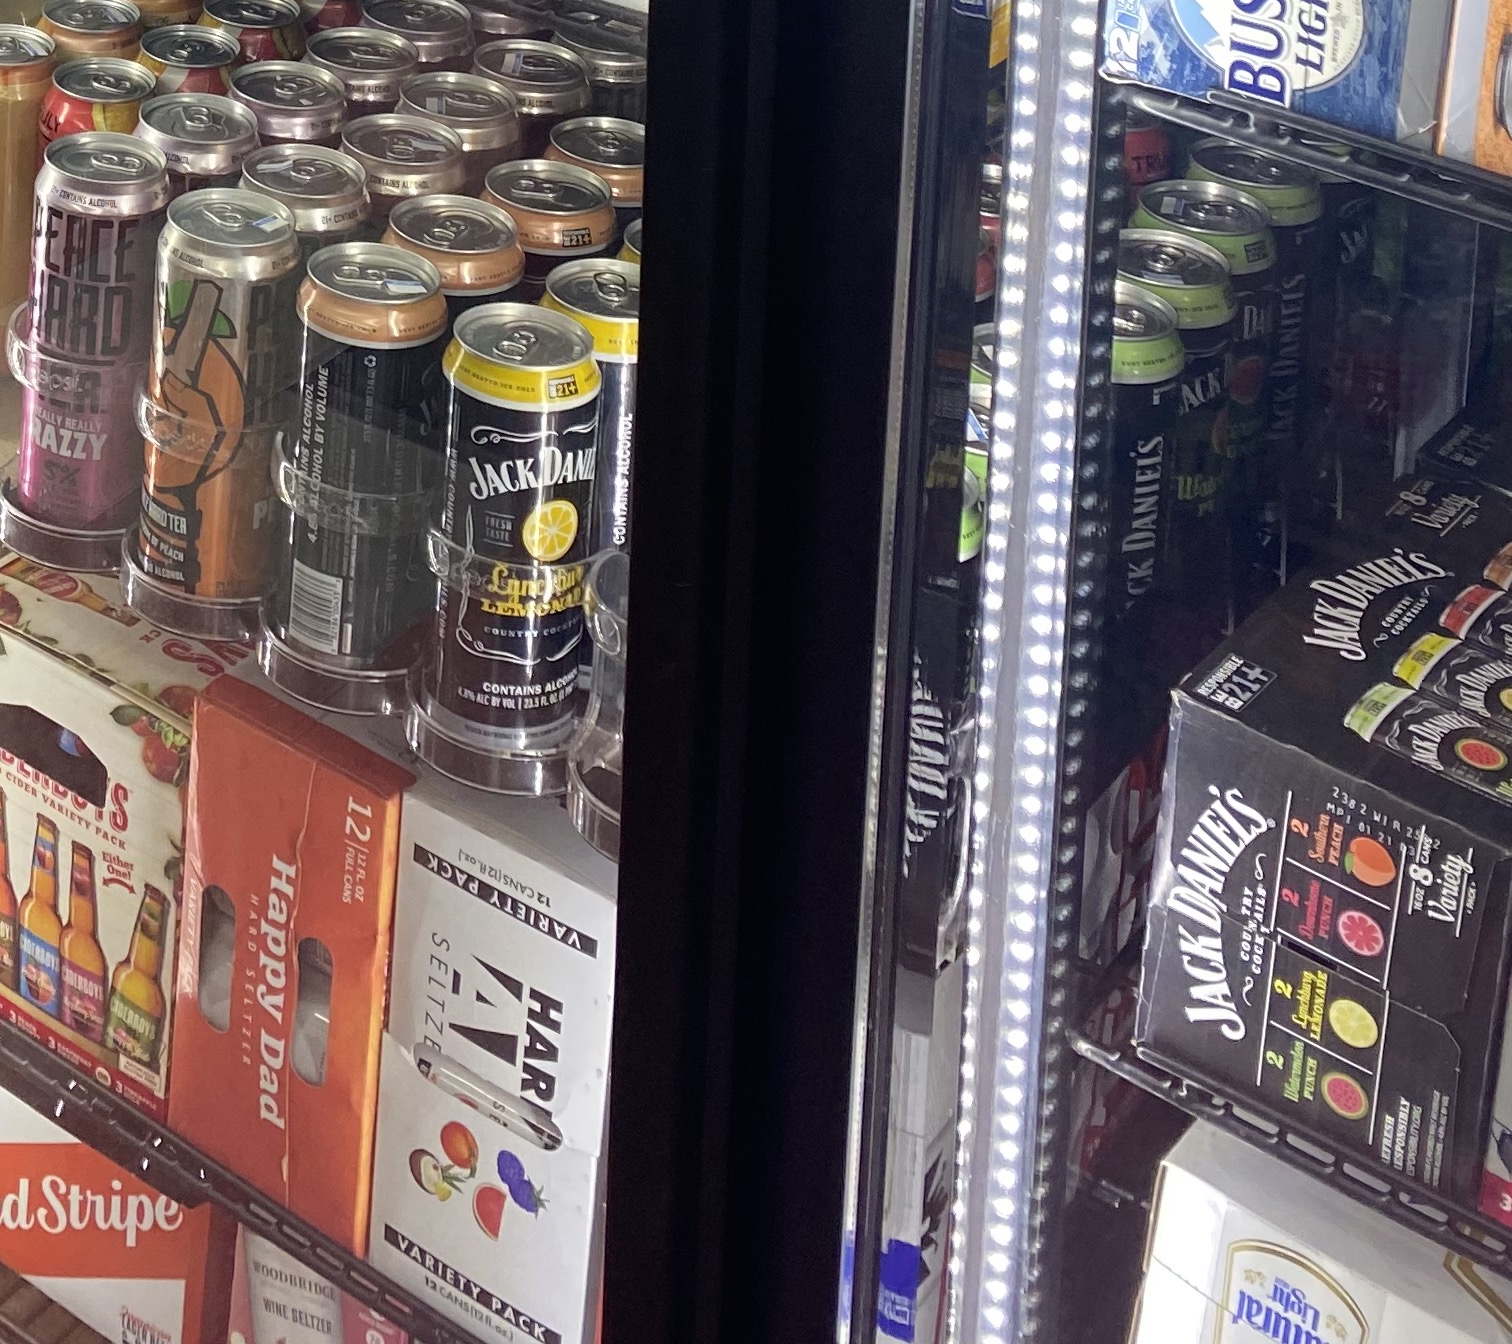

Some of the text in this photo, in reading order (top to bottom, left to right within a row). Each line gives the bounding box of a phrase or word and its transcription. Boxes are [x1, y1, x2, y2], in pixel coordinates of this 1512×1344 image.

[59, 188, 87, 205] CONTAINS
[302, 382, 315, 444] ALCOHOL
[315, 365, 330, 428] VOLUME
[33, 416, 108, 462] RAZZY
[64, 414, 103, 433] REALLY
[469, 455, 538, 501] JACK
[168, 512, 188, 535] TEA
[1410, 492, 1482, 530] Variety
[159, 543, 185, 563] PEACH
[1302, 546, 1449, 662] JACK DANIEL'S
[1381, 595, 1415, 629] COUNTRY
[1390, 596, 1430, 637] COCKTAILS
[484, 625, 539, 639] COUNTRY
[483, 681, 542, 696] CONTAINS
[1196, 654, 1245, 698] RESPONSIBLE
[1225, 666, 1270, 702] 21+
[5, 770, 38, 800] CIDER
[42, 793, 93, 831] VARIETY
[94, 824, 128, 852] PACK
[344, 794, 374, 845] 12
[1289, 816, 1310, 839] 2
[101, 850, 135, 872] Either
[1308, 813, 1332, 863] Southern
[1327, 820, 1345, 867] PEACH
[106, 863, 132, 881] One!
[342, 845, 356, 905] FULL CANS
[502, 872, 552, 909] 12 CANS
[1407, 862, 1434, 887] 8
[1427, 853, 1475, 925] Variety
[426, 852, 582, 951] VARIETY PACK
[1166, 784, 1269, 1041] JACK DANIEL'S
[1280, 886, 1300, 908] 2
[1317, 894, 1334, 940] PUNCH
[1240, 885, 1252, 963] COUNTRY
[1251, 884, 1266, 976] COCKTAILS
[241, 892, 259, 1067] HARD SELTZER
[255, 852, 297, 1131] Happy Dad
[1272, 977, 1293, 1000] 2
[1292, 969, 1314, 1030] Lynchburg
[1309, 970, 1329, 1042] LEMONADE
[520, 986, 564, 1108] HAR
[1265, 1050, 1285, 1071] 2
[1303, 1056, 1318, 1101] PUNCH
[36, 1174, 185, 1248] Stripe
[252, 1259, 337, 1301] WOODBRIDGE
[398, 1232, 548, 1343] VARIETY PACK
[262, 1297, 289, 1320] WINE
